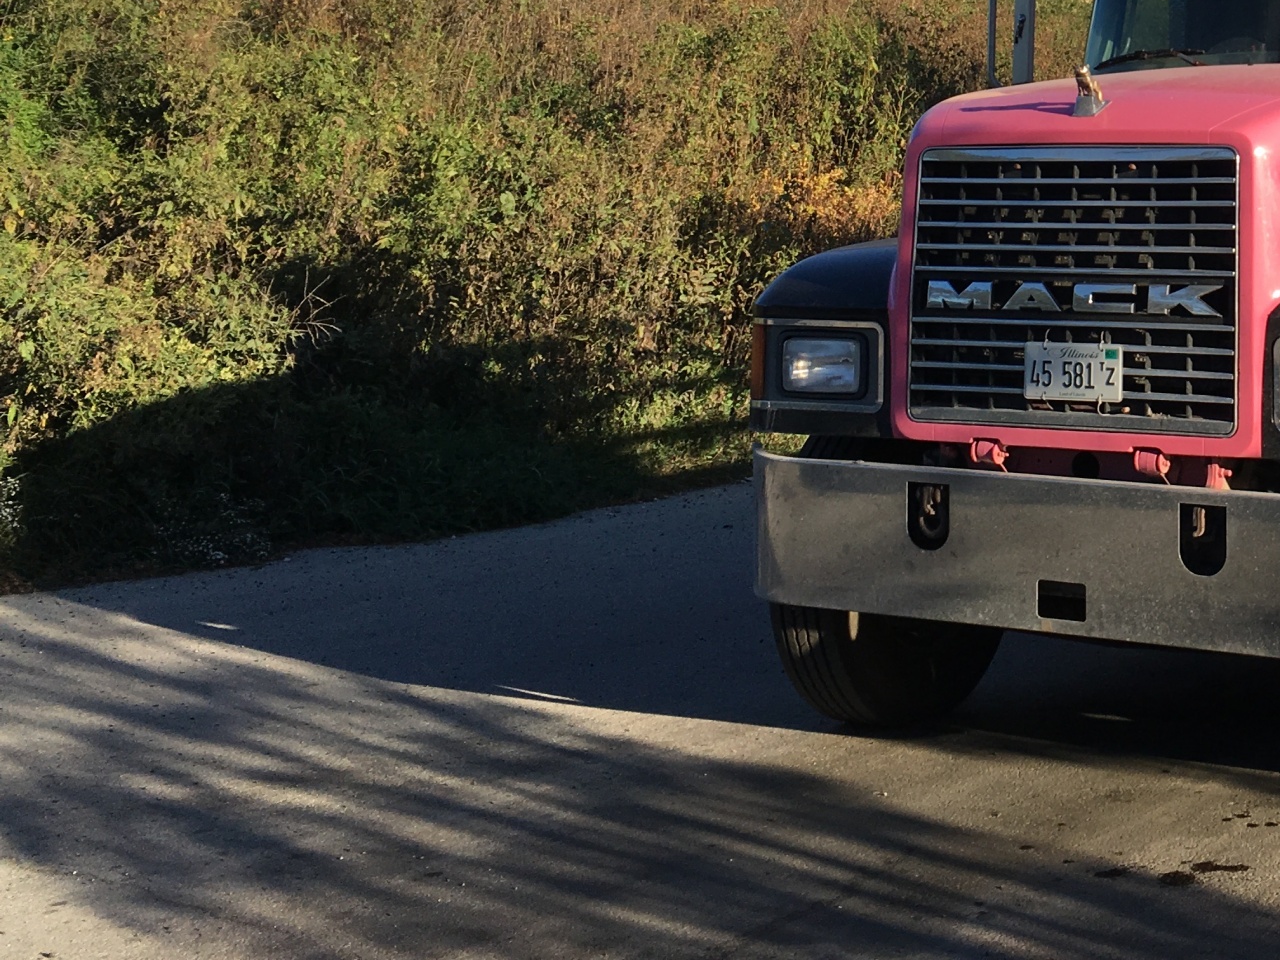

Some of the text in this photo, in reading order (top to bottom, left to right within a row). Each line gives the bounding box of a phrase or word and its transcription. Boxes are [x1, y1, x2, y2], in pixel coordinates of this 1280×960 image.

[926, 280, 1224, 318] MACK
[1049, 347, 1100, 359] Illinois
[1030, 360, 1052, 388] 45
[1062, 361, 1095, 390] 581
